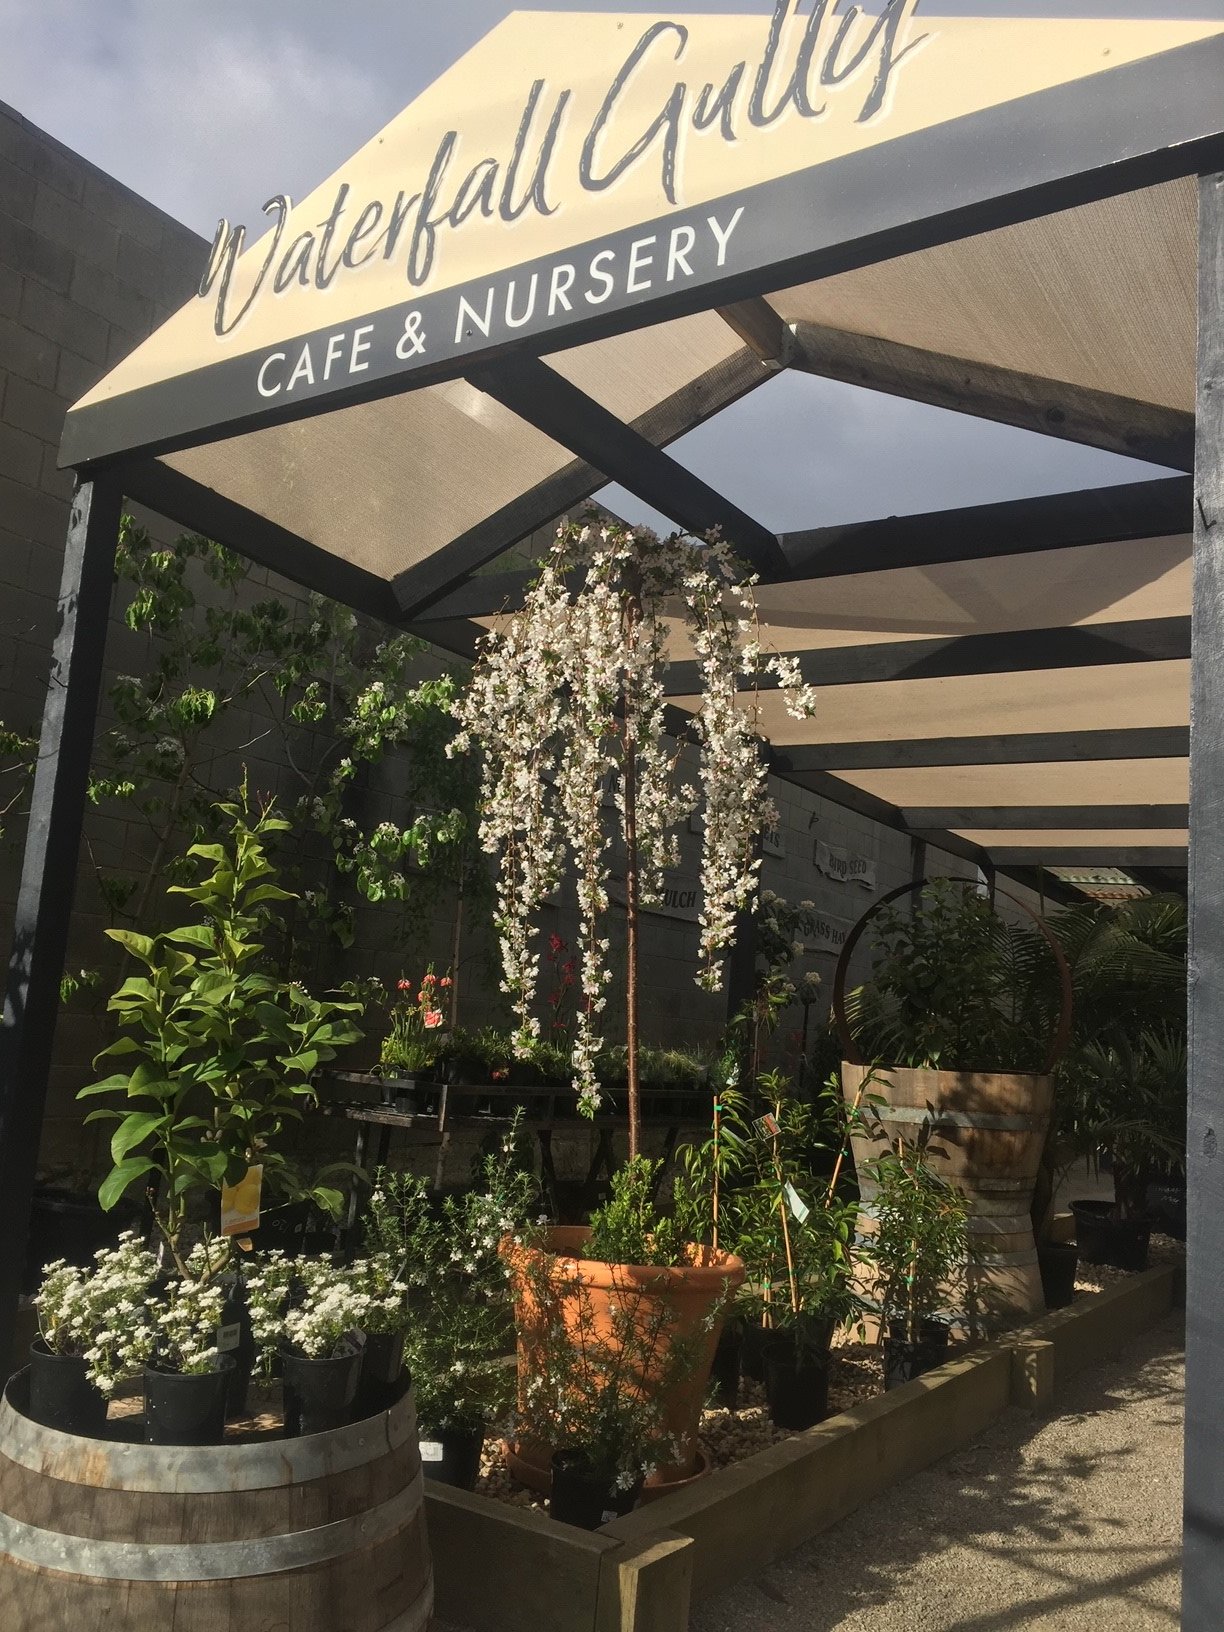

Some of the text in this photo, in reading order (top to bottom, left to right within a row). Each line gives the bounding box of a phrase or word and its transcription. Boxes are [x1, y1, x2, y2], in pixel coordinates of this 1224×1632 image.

[199, 0, 929, 337] Waterfall Gully
[257, 206, 745, 398] CAFE & NURSERY
[660, 887, 697, 908] ULCH
[849, 859, 867, 875] SEED
